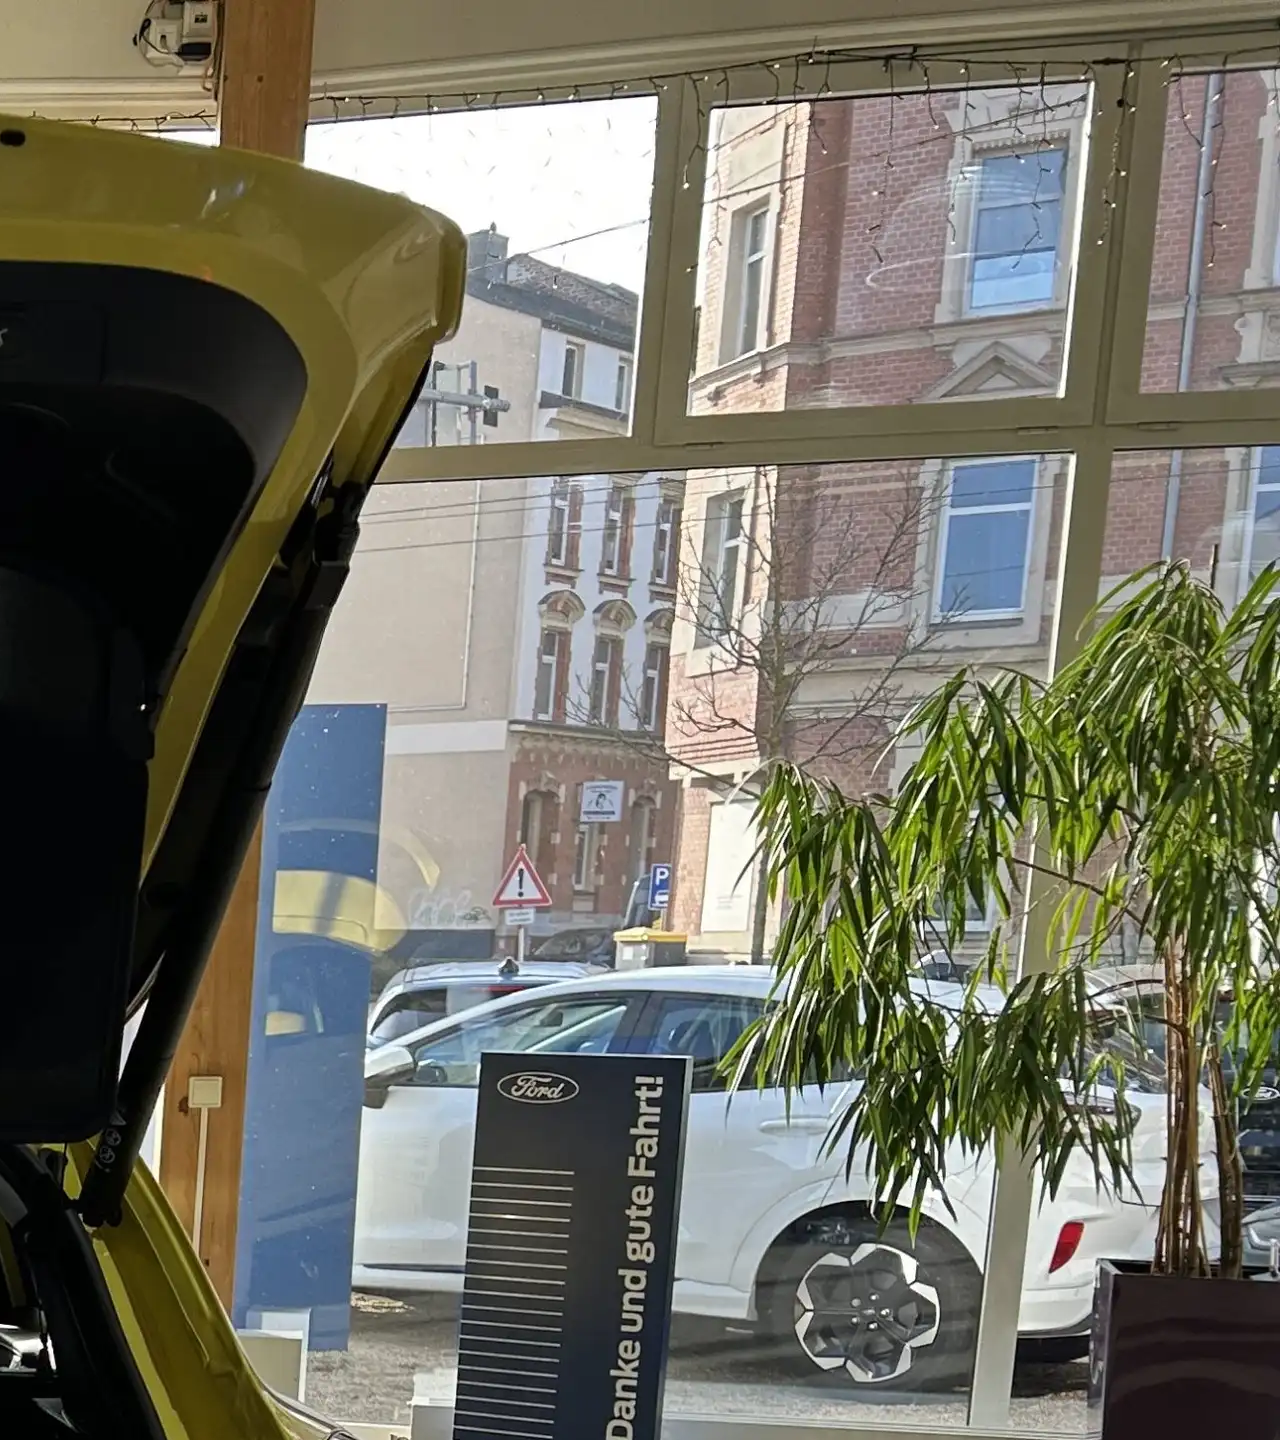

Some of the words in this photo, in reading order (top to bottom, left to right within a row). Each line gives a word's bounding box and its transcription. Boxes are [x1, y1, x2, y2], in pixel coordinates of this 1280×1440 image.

[509, 1074, 567, 1101] Ford
[627, 1075, 665, 1178] Fahrt!
[624, 1184, 656, 1264] gute
[617, 1268, 648, 1333] und
